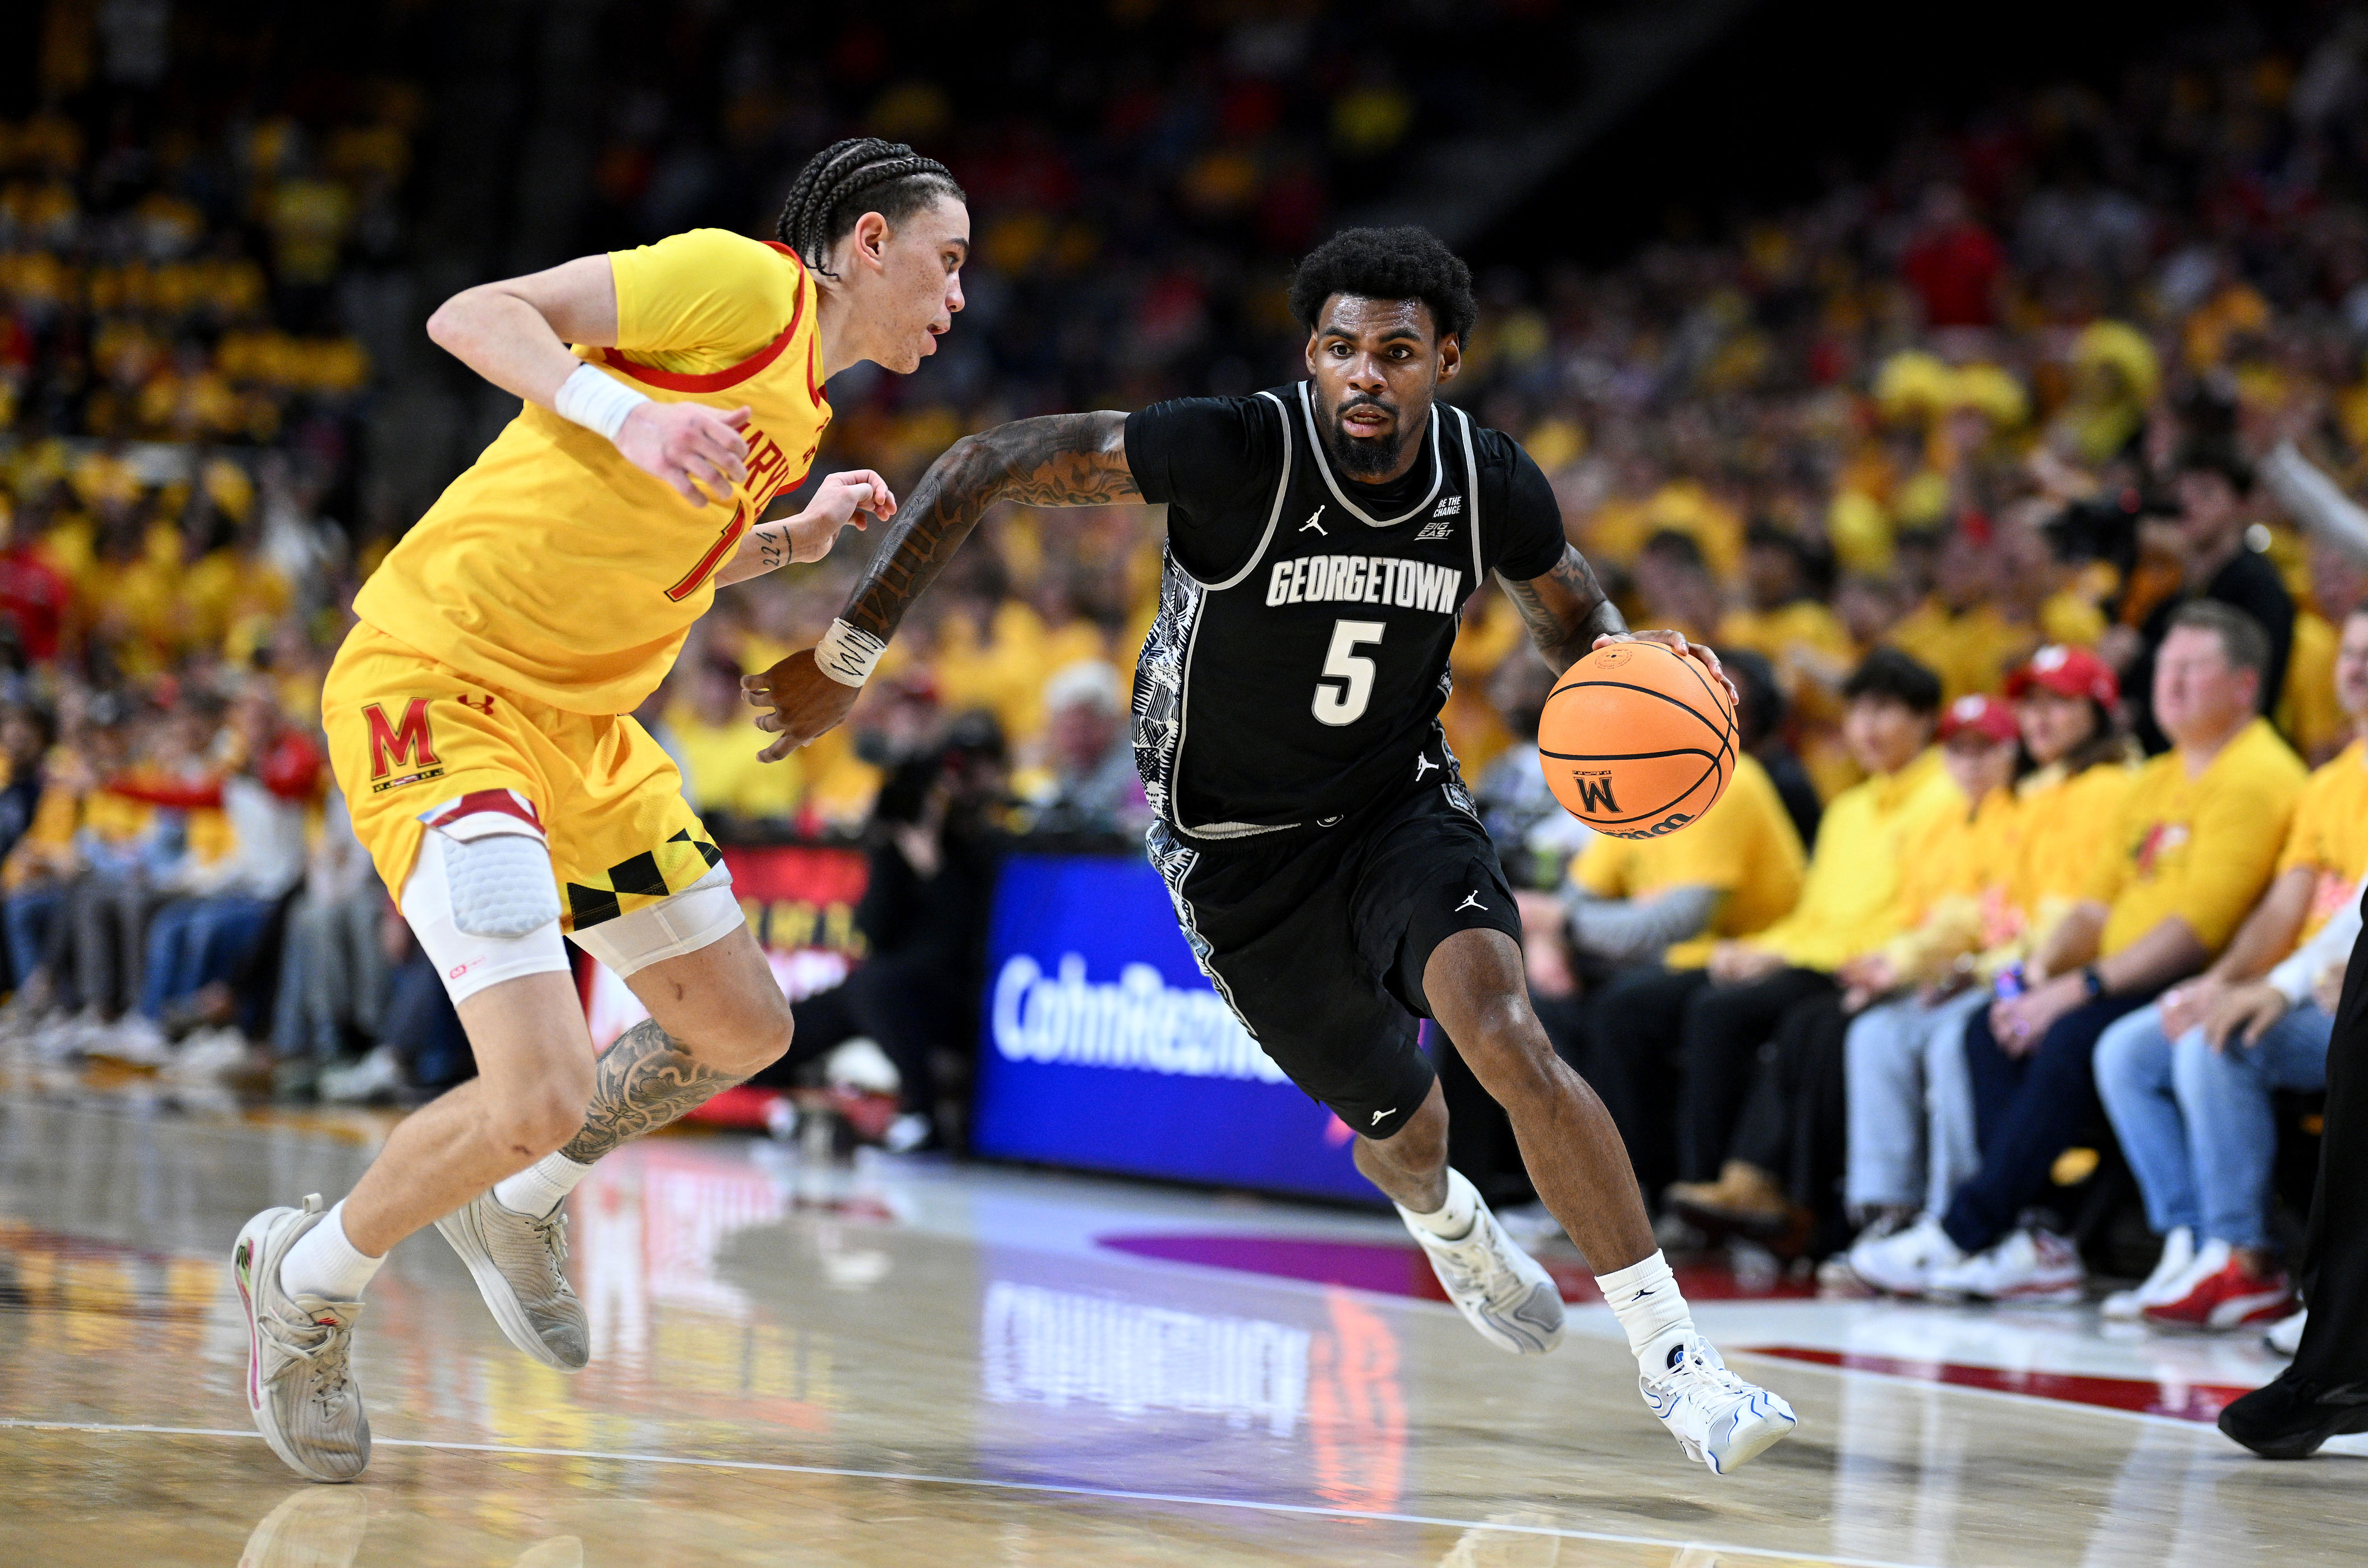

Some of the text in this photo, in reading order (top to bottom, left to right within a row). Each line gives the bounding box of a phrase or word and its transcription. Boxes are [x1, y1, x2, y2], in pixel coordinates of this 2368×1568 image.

[1433, 505, 1462, 518] CHANGE
[1437, 496, 1462, 508] BE THE
[1417, 529, 1454, 537] EAST
[1424, 522, 1450, 530] BIG
[756, 531, 781, 567] 224
[1265, 554, 1462, 614] GEORGETOWN
[1311, 619, 1387, 726] 5
[361, 697, 442, 781] M
